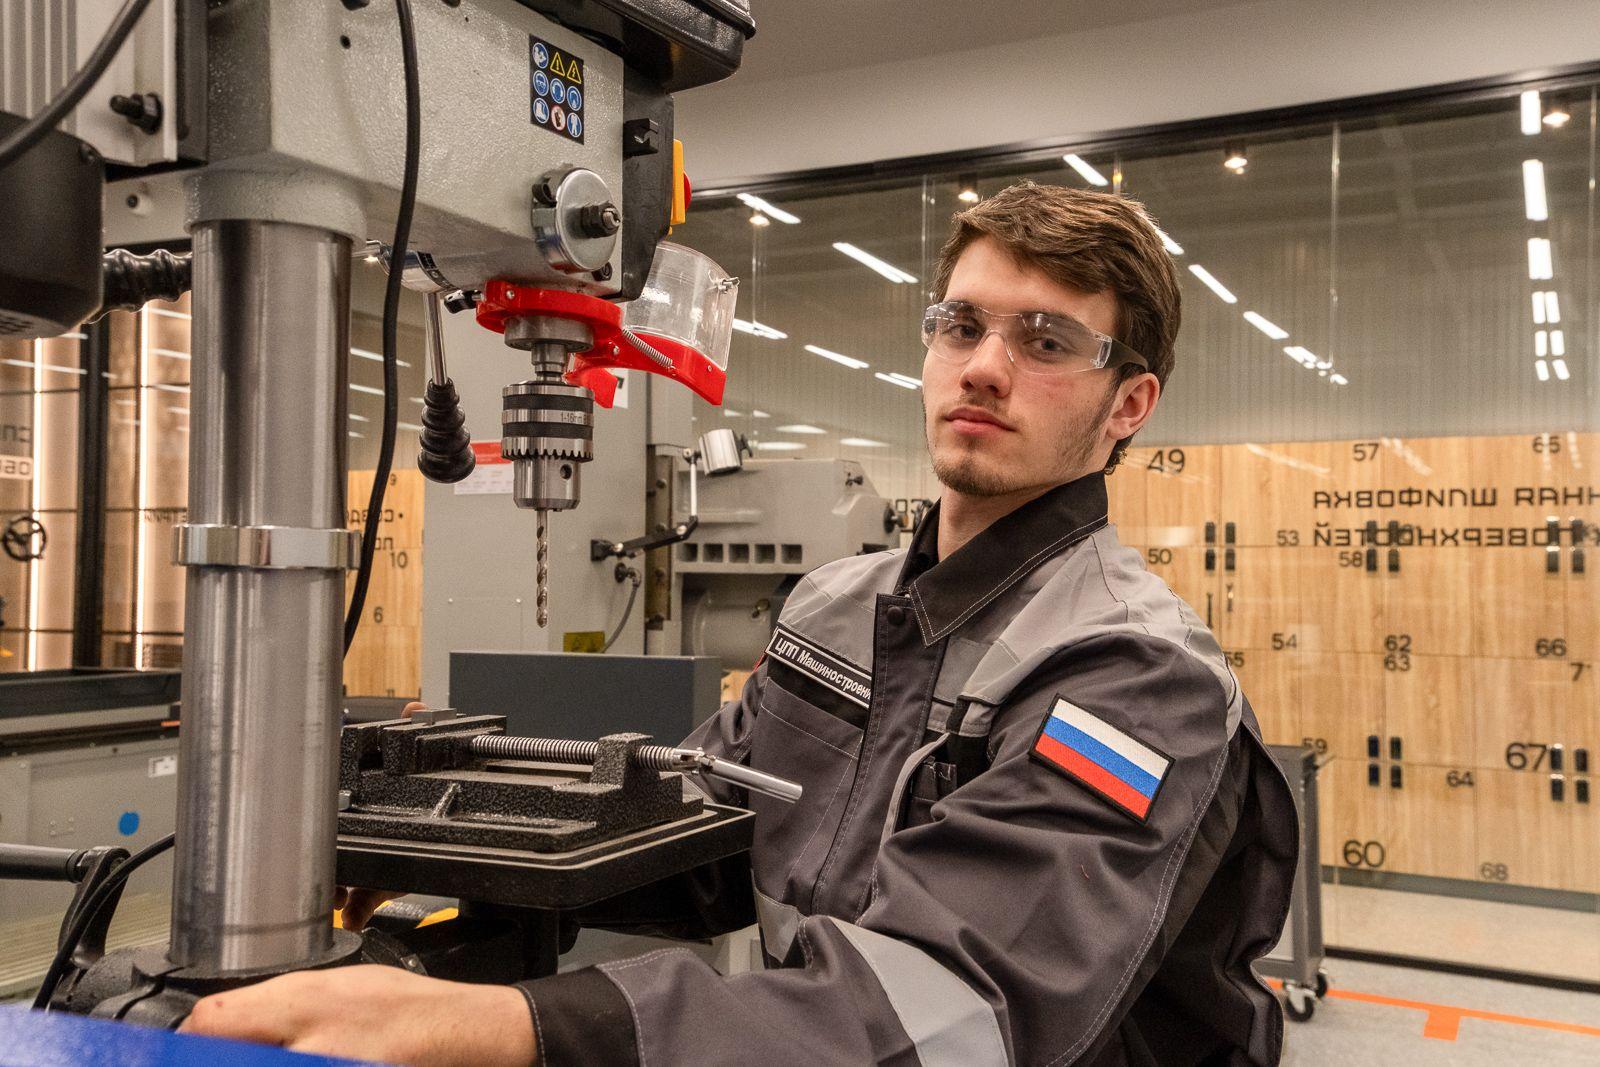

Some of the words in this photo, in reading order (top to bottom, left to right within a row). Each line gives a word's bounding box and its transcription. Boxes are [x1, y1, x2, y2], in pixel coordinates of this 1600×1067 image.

[1353, 443, 1380, 462] 57
[1532, 436, 1561, 454] 65
[1146, 448, 1185, 473] 49
[1277, 529, 1300, 547] 53
[391, 551, 408, 569] 10
[1147, 548, 1172, 566] 50
[1339, 552, 1362, 569] 58
[374, 606, 383, 623] 6
[774, 638, 800, 659] ЦПП
[1272, 633, 1297, 651] 54
[1384, 634, 1412, 653] 62
[1535, 638, 1567, 657] 66
[1383, 654, 1410, 672] 63
[1505, 742, 1548, 772] 67
[1446, 770, 1475, 788] 64
[1343, 839, 1386, 868] 60
[1480, 862, 1509, 882] 68
